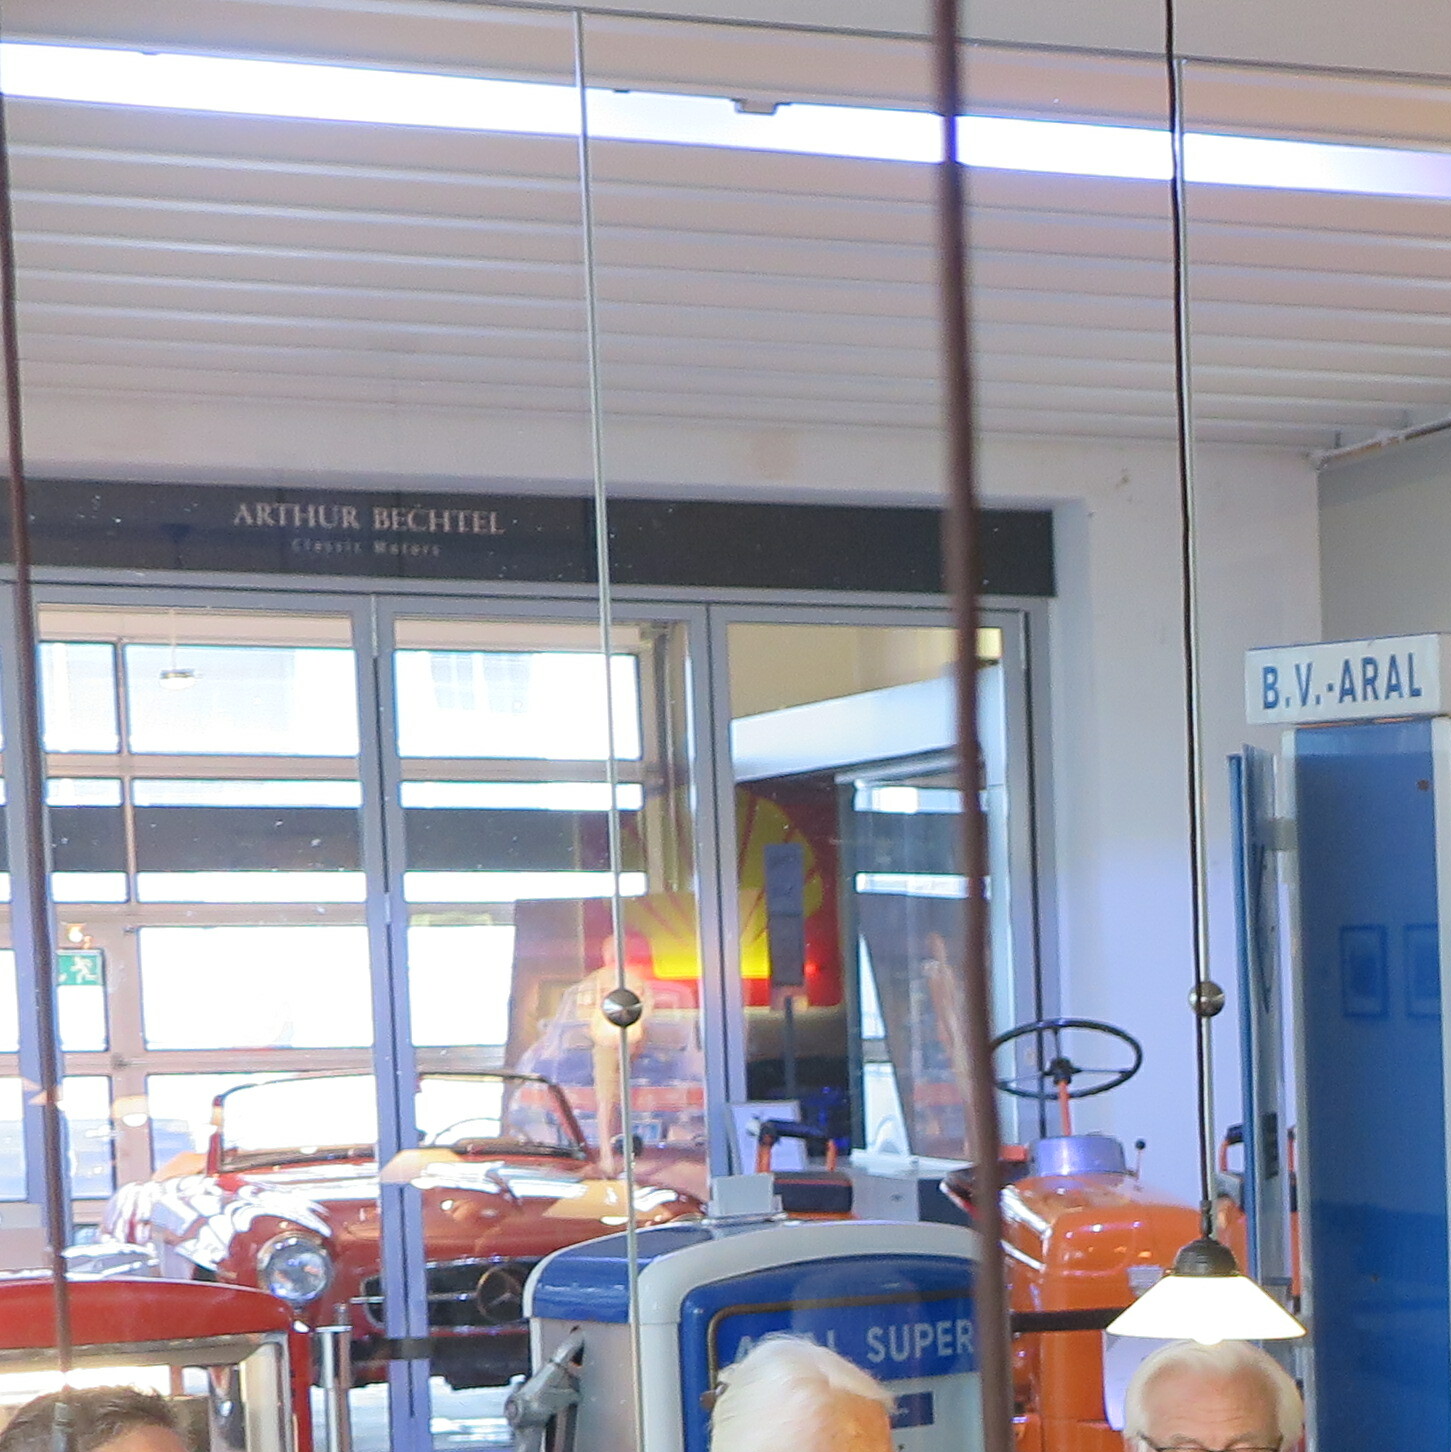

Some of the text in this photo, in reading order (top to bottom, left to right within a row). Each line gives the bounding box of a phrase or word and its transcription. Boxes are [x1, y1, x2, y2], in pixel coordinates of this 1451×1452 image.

[233, 502, 505, 535] ARTHUR BECHTEL
[1262, 652, 1422, 710] B.V.-ARAL
[866, 1318, 974, 1364] SUPER
